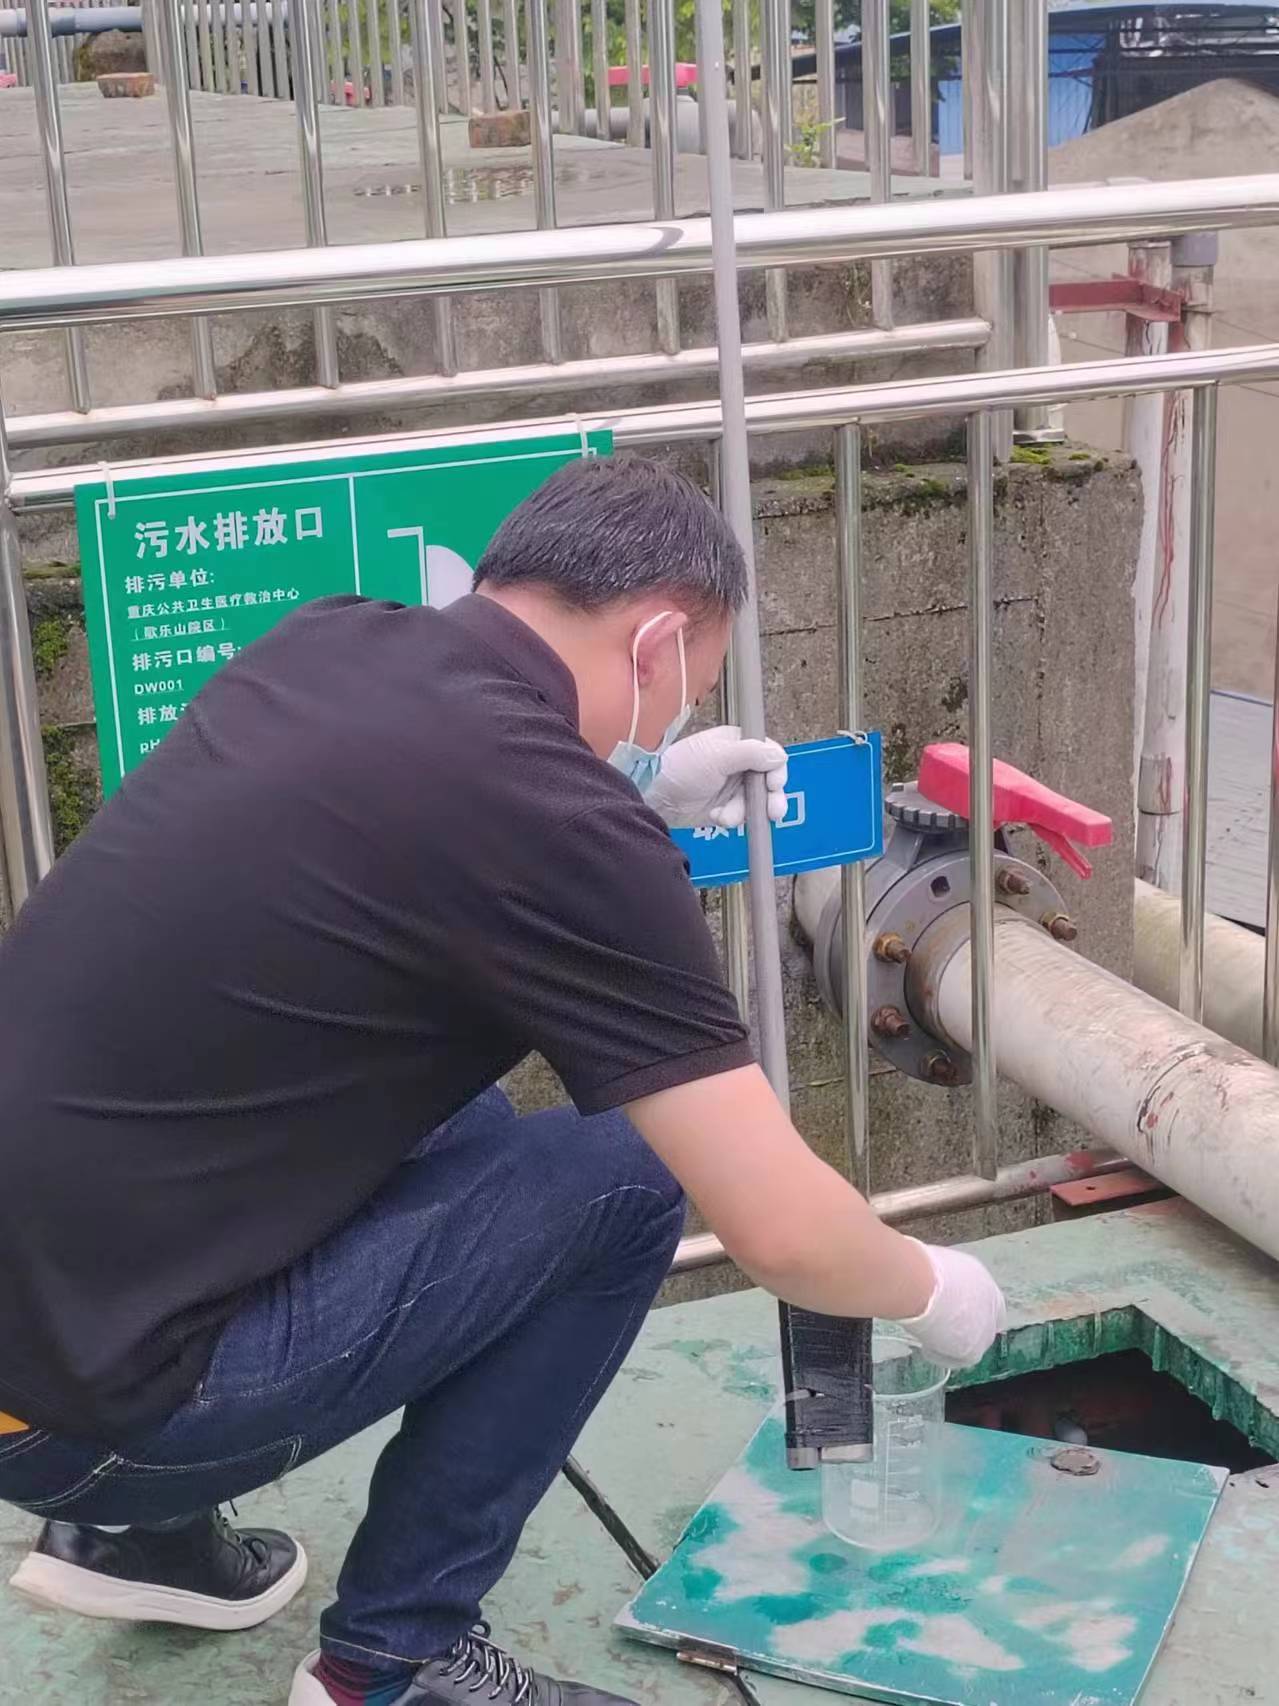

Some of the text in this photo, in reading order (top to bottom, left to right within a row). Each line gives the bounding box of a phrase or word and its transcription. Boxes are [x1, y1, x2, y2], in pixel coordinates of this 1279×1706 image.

[134, 506, 323, 559] 污水排放口
[127, 588, 300, 619] 重庆公共卫生医疗救治中心
[134, 680, 183, 695] DW001
